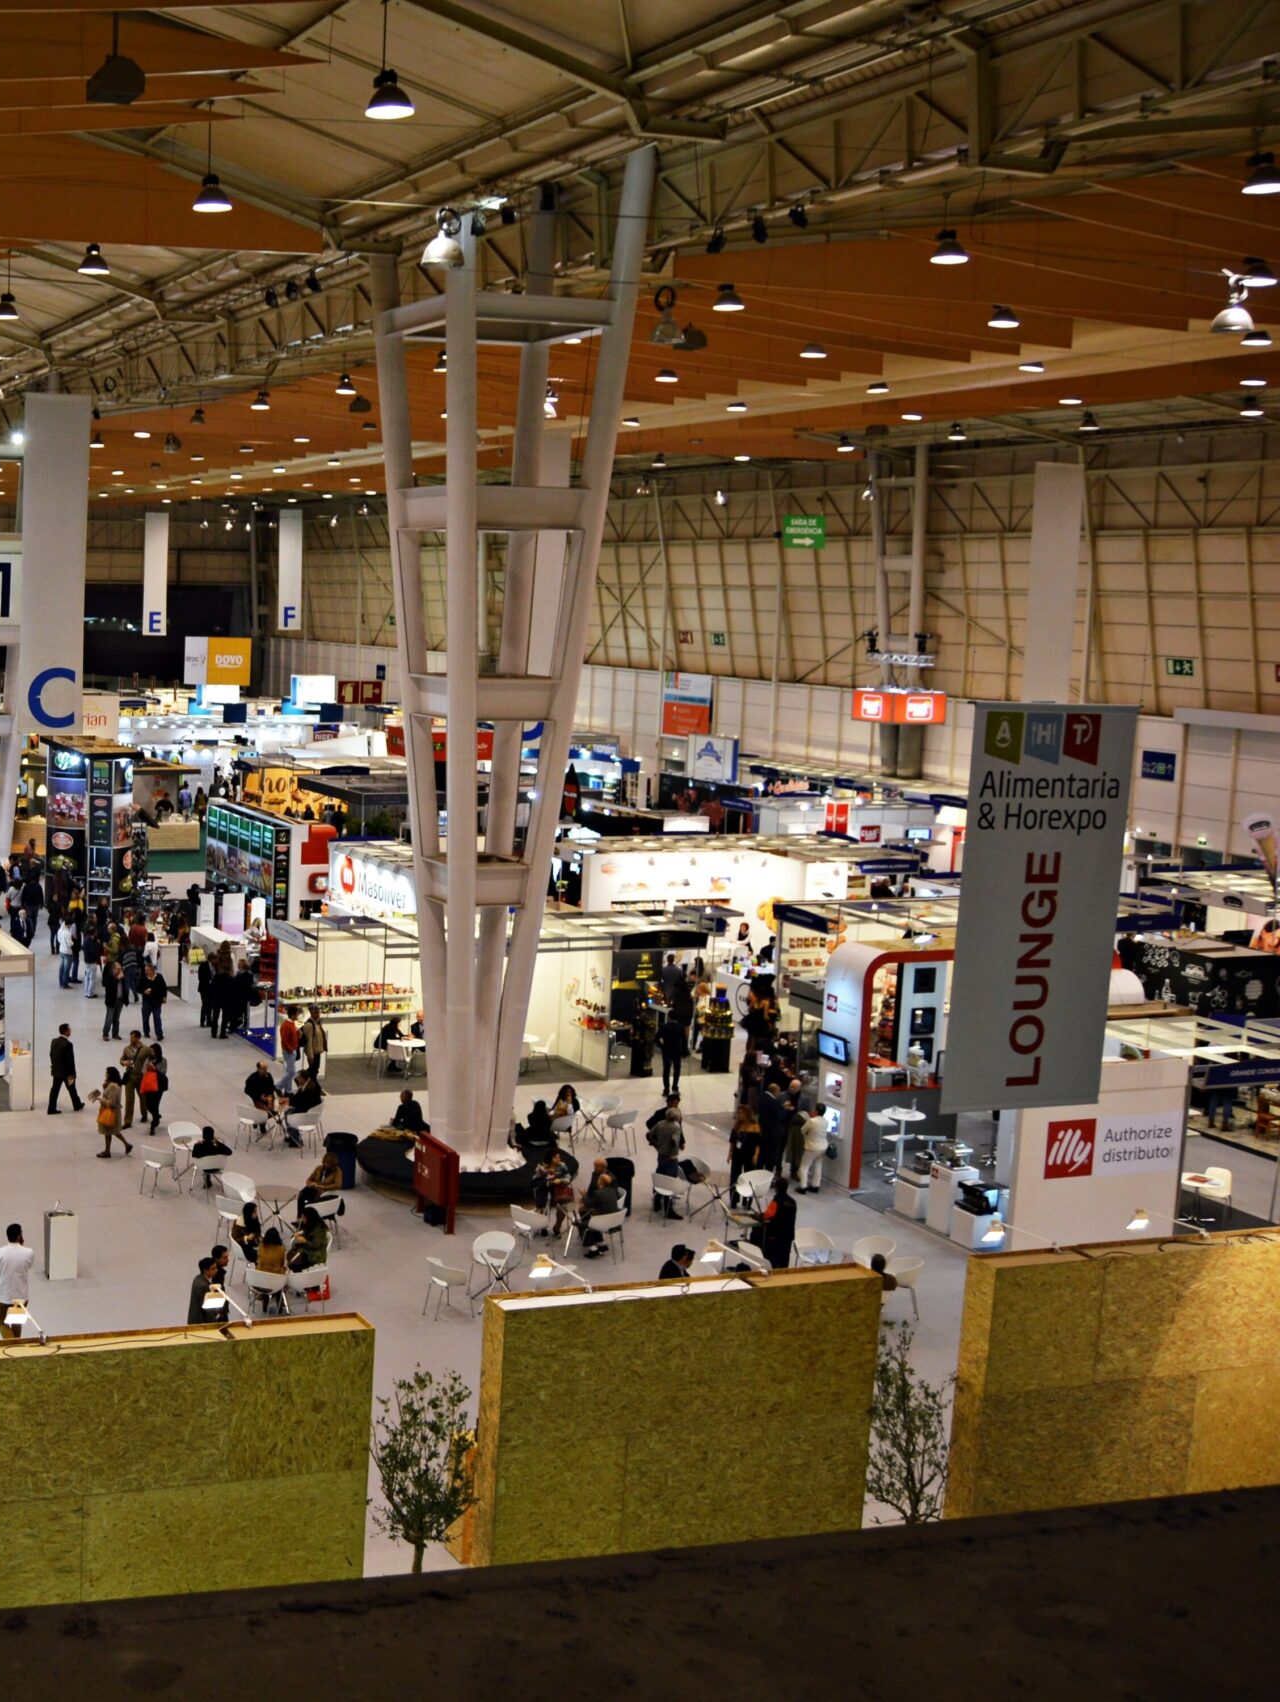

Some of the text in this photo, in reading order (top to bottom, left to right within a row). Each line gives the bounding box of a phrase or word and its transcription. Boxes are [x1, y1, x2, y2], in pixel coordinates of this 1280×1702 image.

[149, 611, 161, 633] E
[284, 606, 296, 628] F
[28, 666, 76, 728] C
[979, 770, 1120, 799] Alimentaria
[977, 802, 1107, 836] & Horexpo
[1005, 851, 1062, 1087] LOUNGE
[1104, 1125, 1172, 1142] Authorize
[1048, 1128, 1092, 1172] illy
